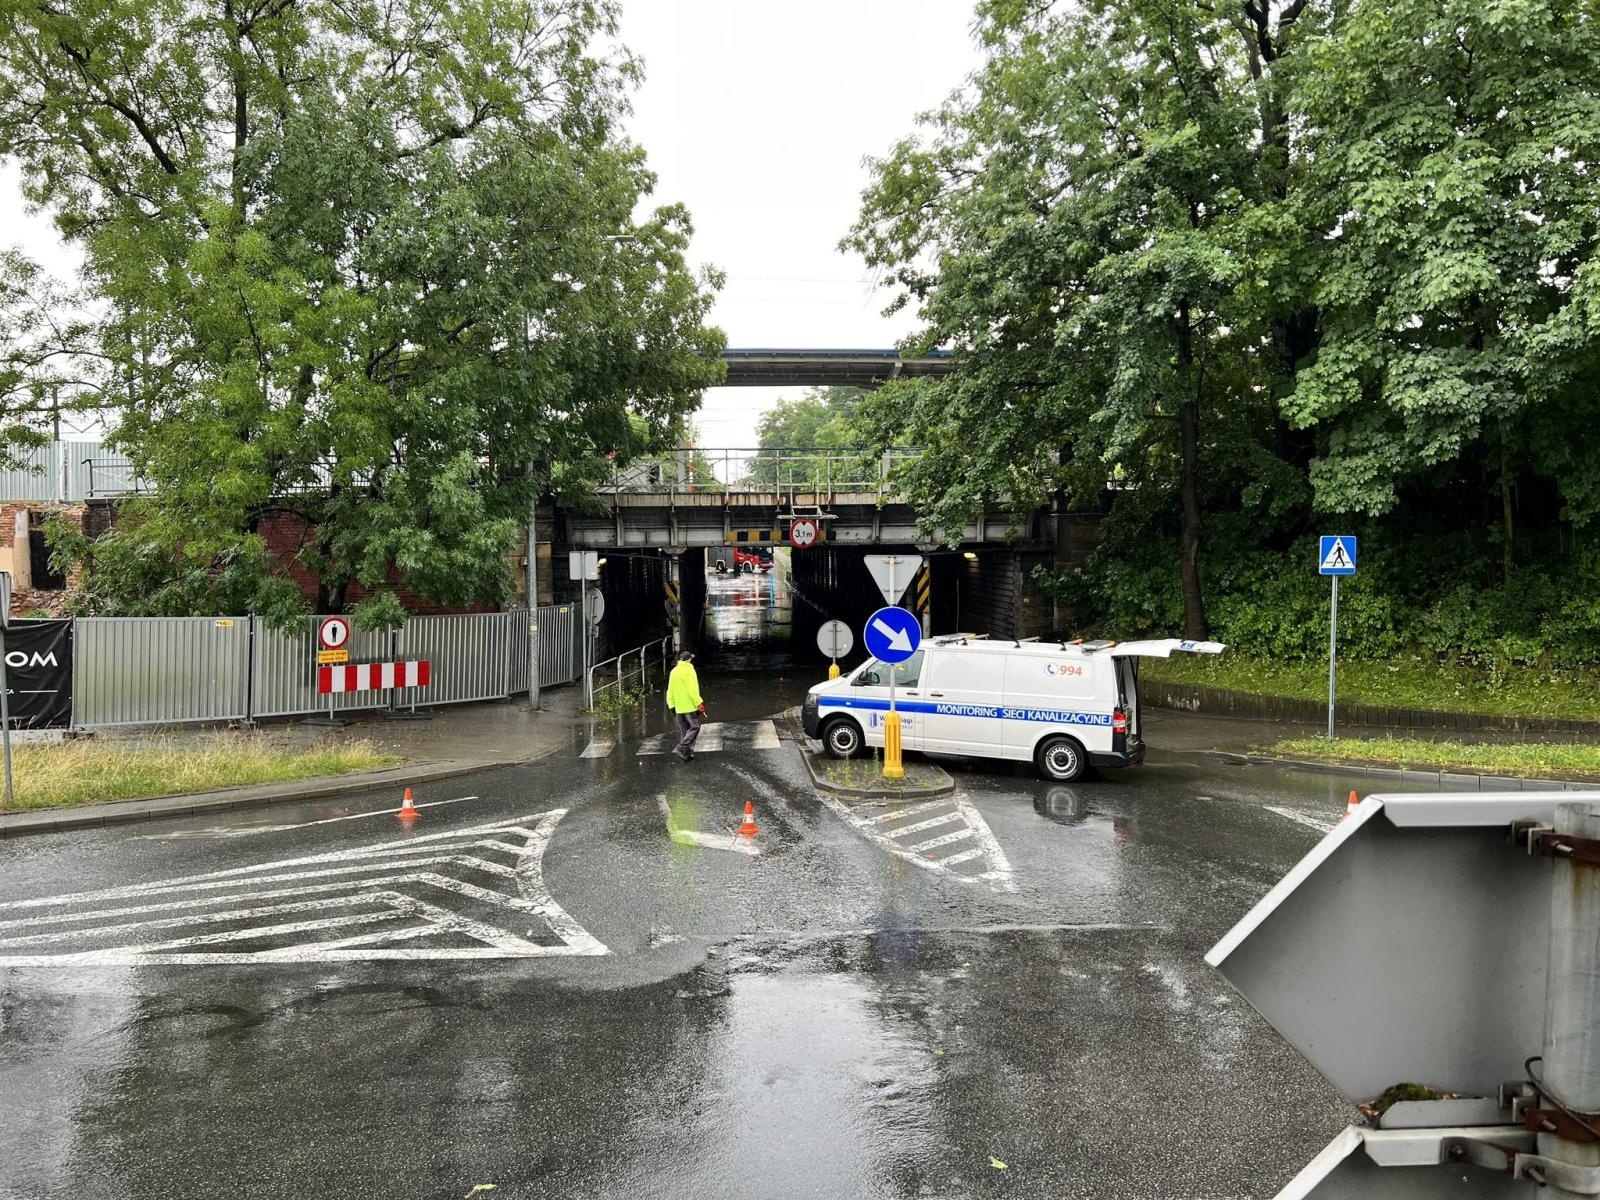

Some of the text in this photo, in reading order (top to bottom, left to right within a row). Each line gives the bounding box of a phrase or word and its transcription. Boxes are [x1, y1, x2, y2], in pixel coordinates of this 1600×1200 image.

[1060, 665, 1082, 677] 994
[936, 704, 1112, 725] MONITORING SIECI KANALIZACYJNEJ
